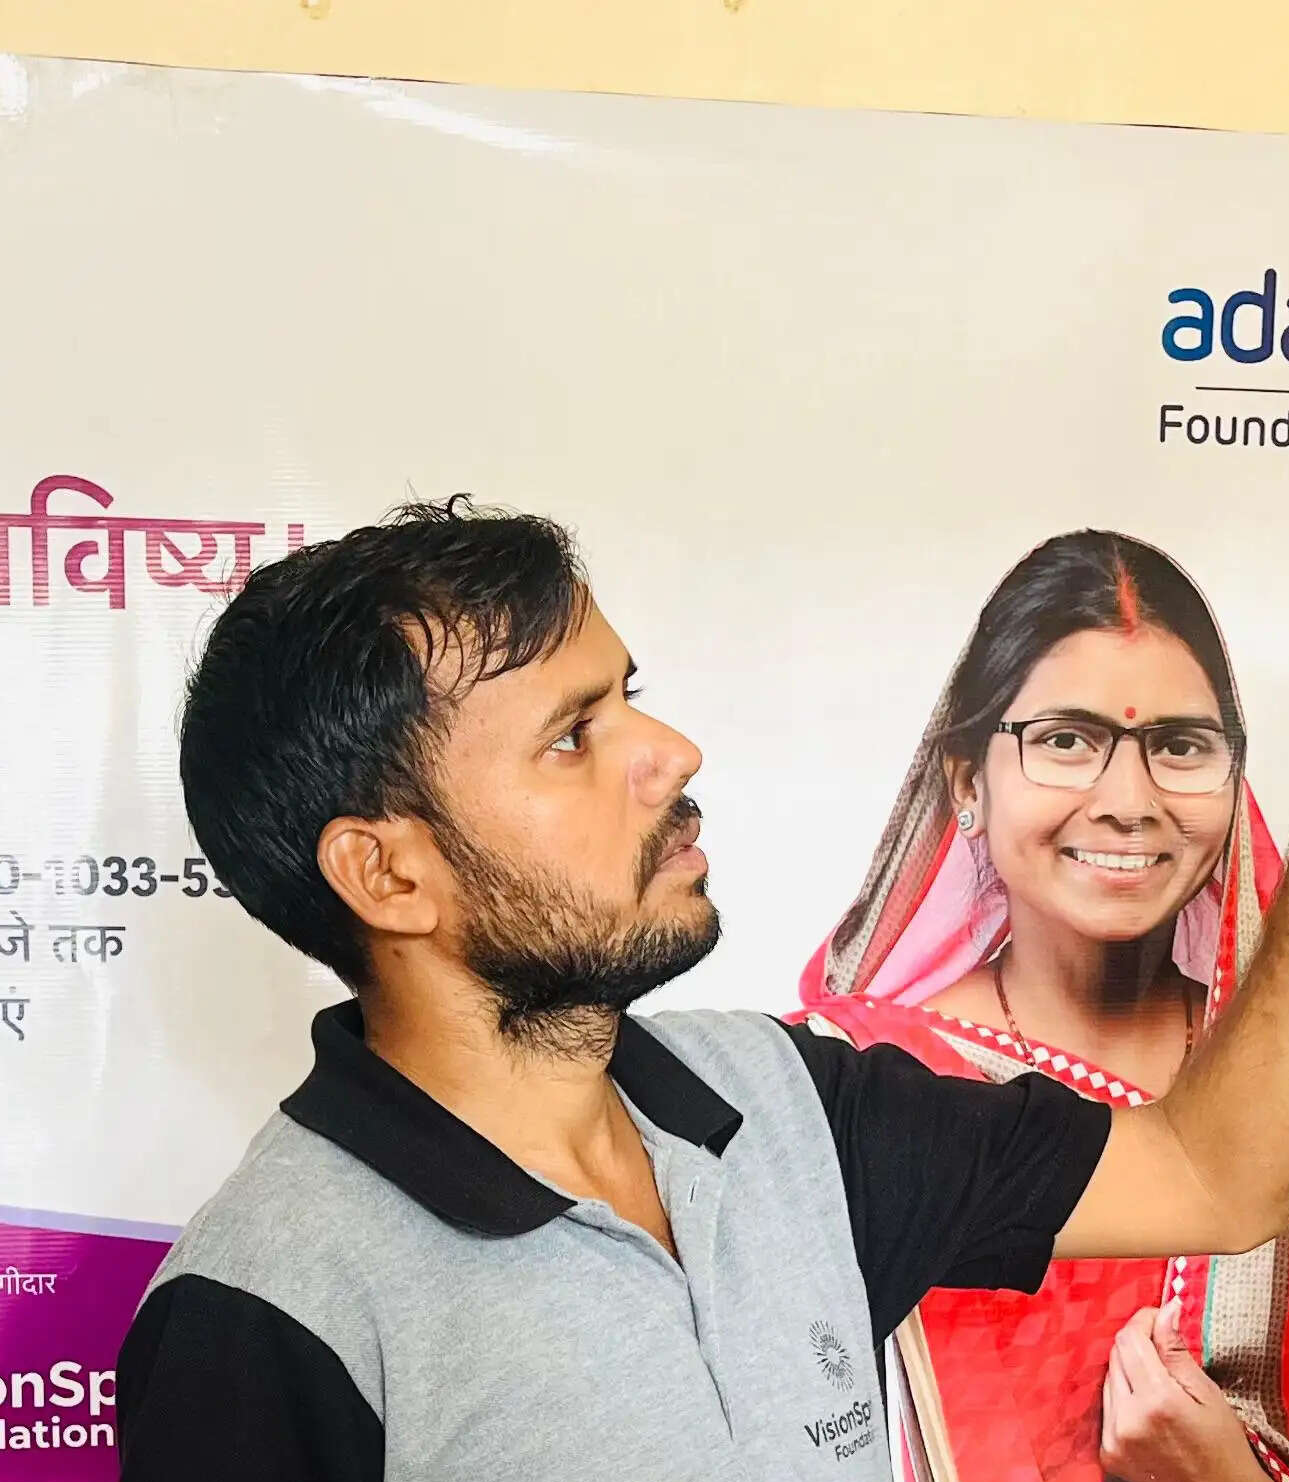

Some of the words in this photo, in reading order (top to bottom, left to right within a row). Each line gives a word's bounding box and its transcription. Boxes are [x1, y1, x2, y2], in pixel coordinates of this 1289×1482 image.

[48, 925, 127, 964] तक
[804, 1399, 873, 1448] VisionSp
[834, 1430, 874, 1462] Foundat
